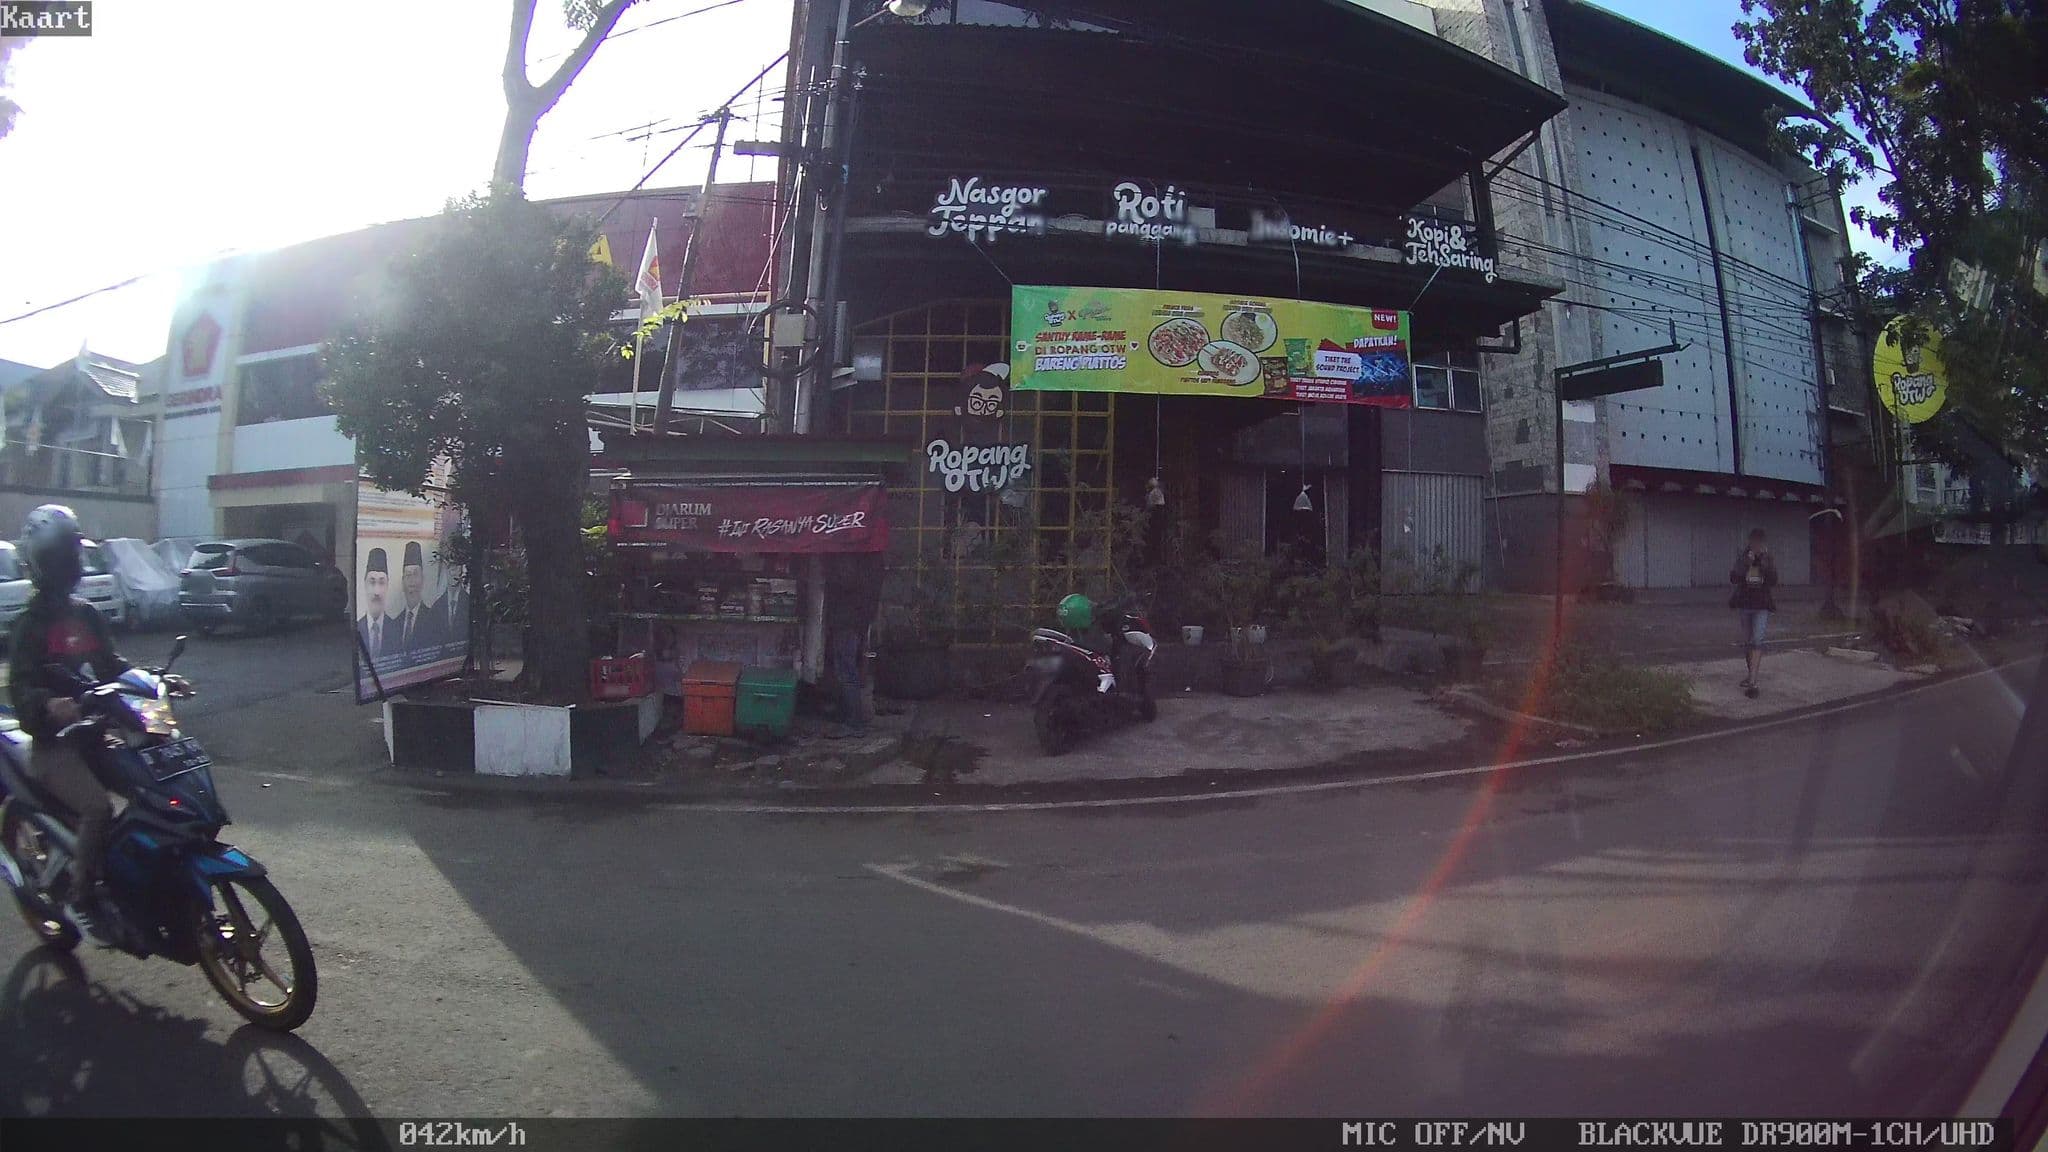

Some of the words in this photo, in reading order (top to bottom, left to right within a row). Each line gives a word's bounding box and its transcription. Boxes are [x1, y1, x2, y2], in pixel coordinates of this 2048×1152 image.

[937, 176, 1046, 217] Nasgor
[1113, 182, 1186, 225] Roti
[1106, 222, 1200, 245] pangga
[1250, 210, 1354, 247] omie+
[1373, 313, 1397, 323] NEW!
[1050, 344, 1098, 355] ROPANG
[1101, 343, 1127, 354] OTW
[1353, 335, 1398, 349] DAPATKAN!
[1892, 372, 1936, 396] Ropang
[1900, 388, 1926, 405] OTW
[927, 439, 1031, 479] Ropang
[945, 465, 1008, 492] OTW
[656, 503, 712, 516] DJARUM
